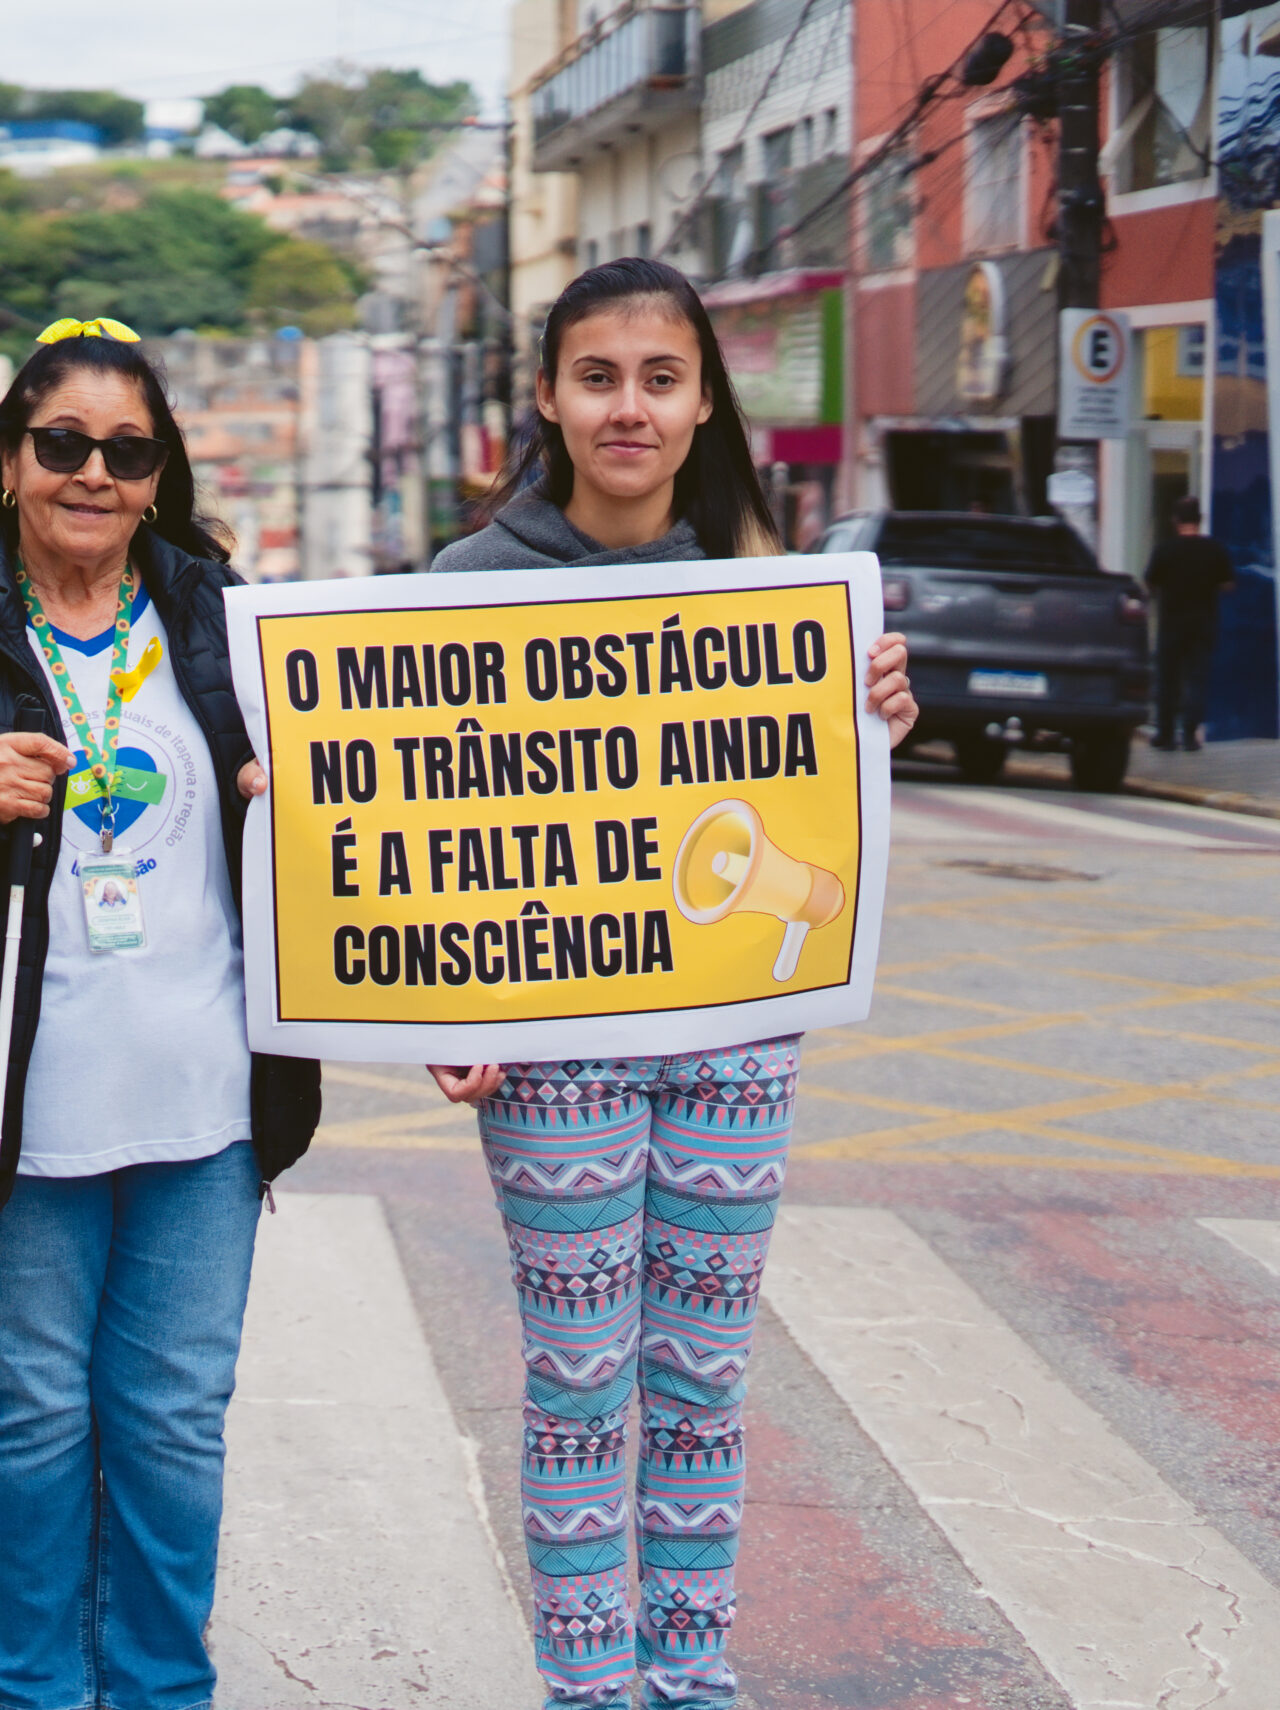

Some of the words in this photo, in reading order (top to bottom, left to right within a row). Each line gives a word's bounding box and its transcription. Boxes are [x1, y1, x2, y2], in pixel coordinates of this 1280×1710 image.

[1090, 329, 1110, 368] E
[285, 648, 320, 712] O
[335, 640, 508, 711] MAIOR
[524, 612, 828, 702] OBSTÁCULO
[154, 725, 172, 739] de
[170, 734, 197, 786] itapeva
[309, 737, 378, 805] NO
[393, 717, 639, 801] TRÂNSITO
[659, 712, 819, 786] AINDA
[184, 789, 196, 799] e
[165, 802, 193, 847] região
[331, 816, 360, 897] É
[378, 831, 412, 897] A
[428, 822, 579, 894] FALTA
[594, 816, 663, 884] DE
[333, 900, 675, 987] CONSCIÊNCIA
